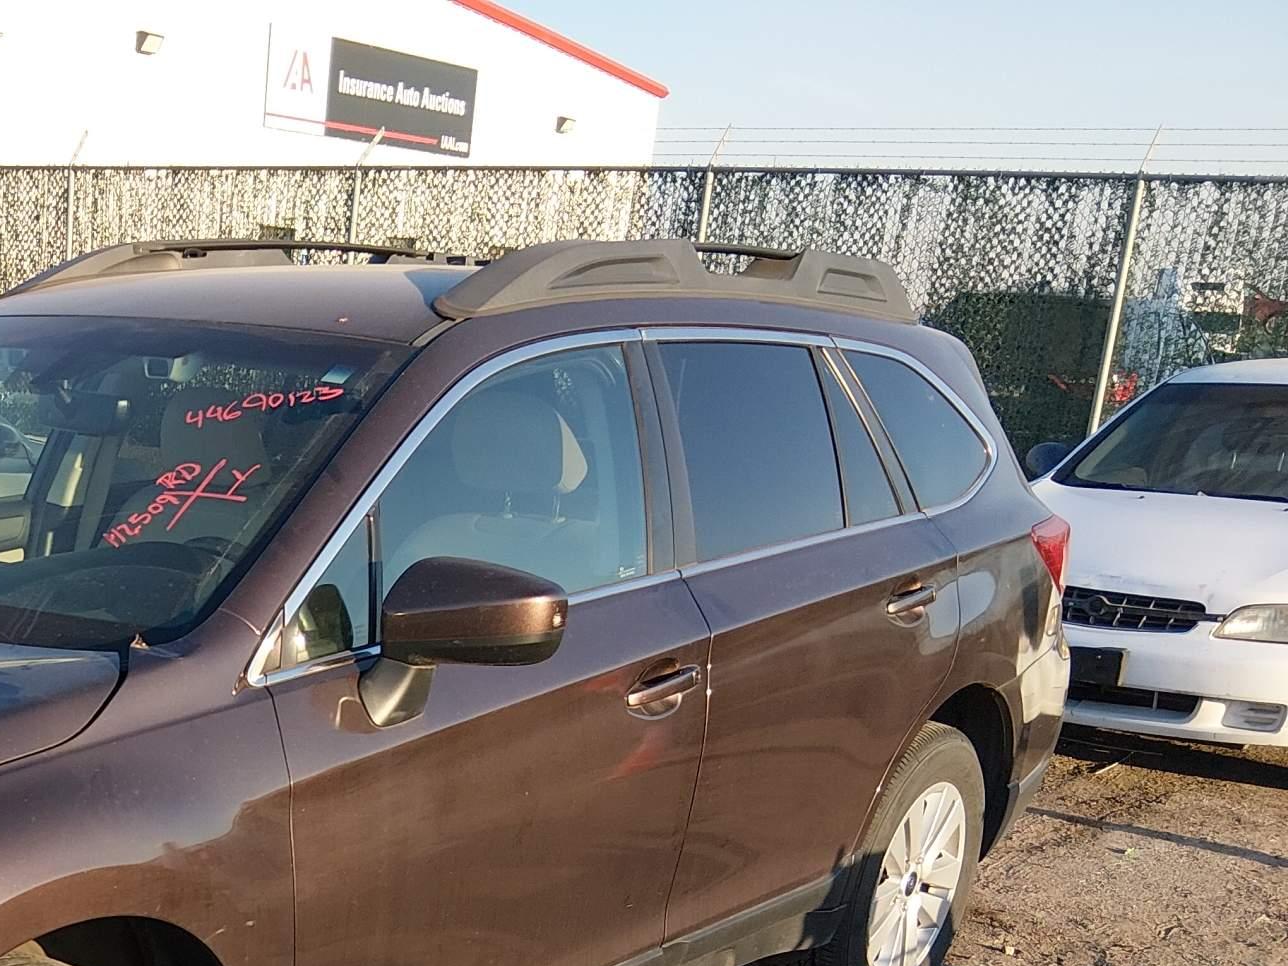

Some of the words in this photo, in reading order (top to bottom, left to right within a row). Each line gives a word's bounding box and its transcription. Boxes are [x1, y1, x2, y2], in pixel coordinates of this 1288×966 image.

[338, 70, 394, 103] Insurance
[395, 81, 420, 107] Auto
[421, 87, 466, 116] Auctions
[185, 385, 345, 428] 44690123
